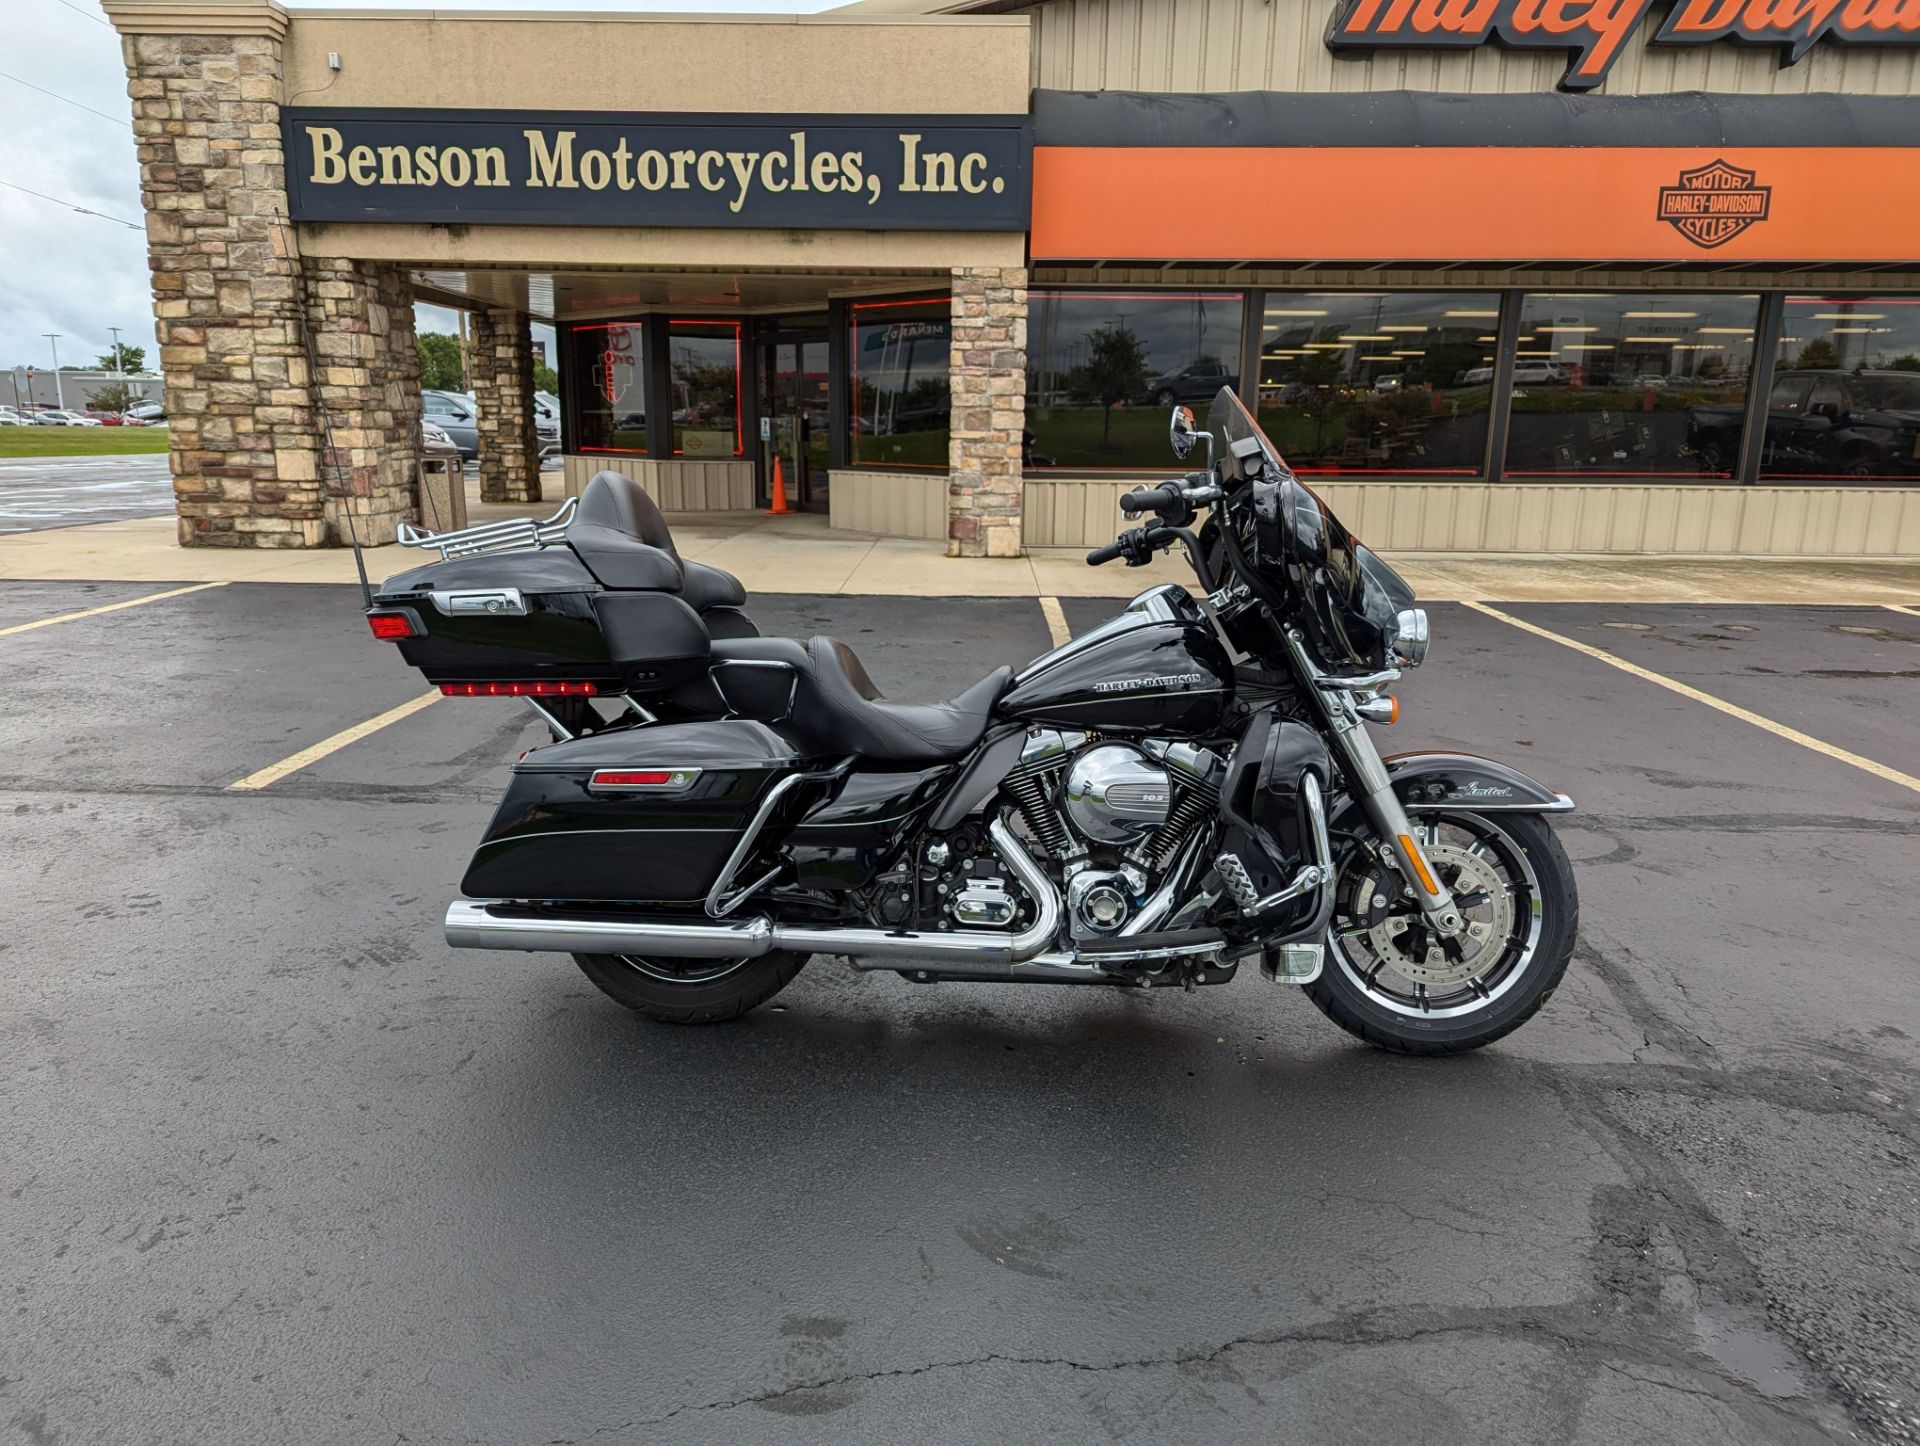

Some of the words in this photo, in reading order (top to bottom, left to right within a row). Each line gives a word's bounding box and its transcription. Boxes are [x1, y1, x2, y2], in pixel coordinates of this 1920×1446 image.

[305, 126, 511, 187] Benson
[522, 129, 881, 213] Motorcycles,
[898, 133, 1006, 194] Inc.
[1691, 168, 1742, 189] MOTOR
[1666, 195, 1762, 213] HARLEY-DAVIDSON
[1686, 219, 1736, 241] CYCLES
[604, 350, 618, 403] OPEN
